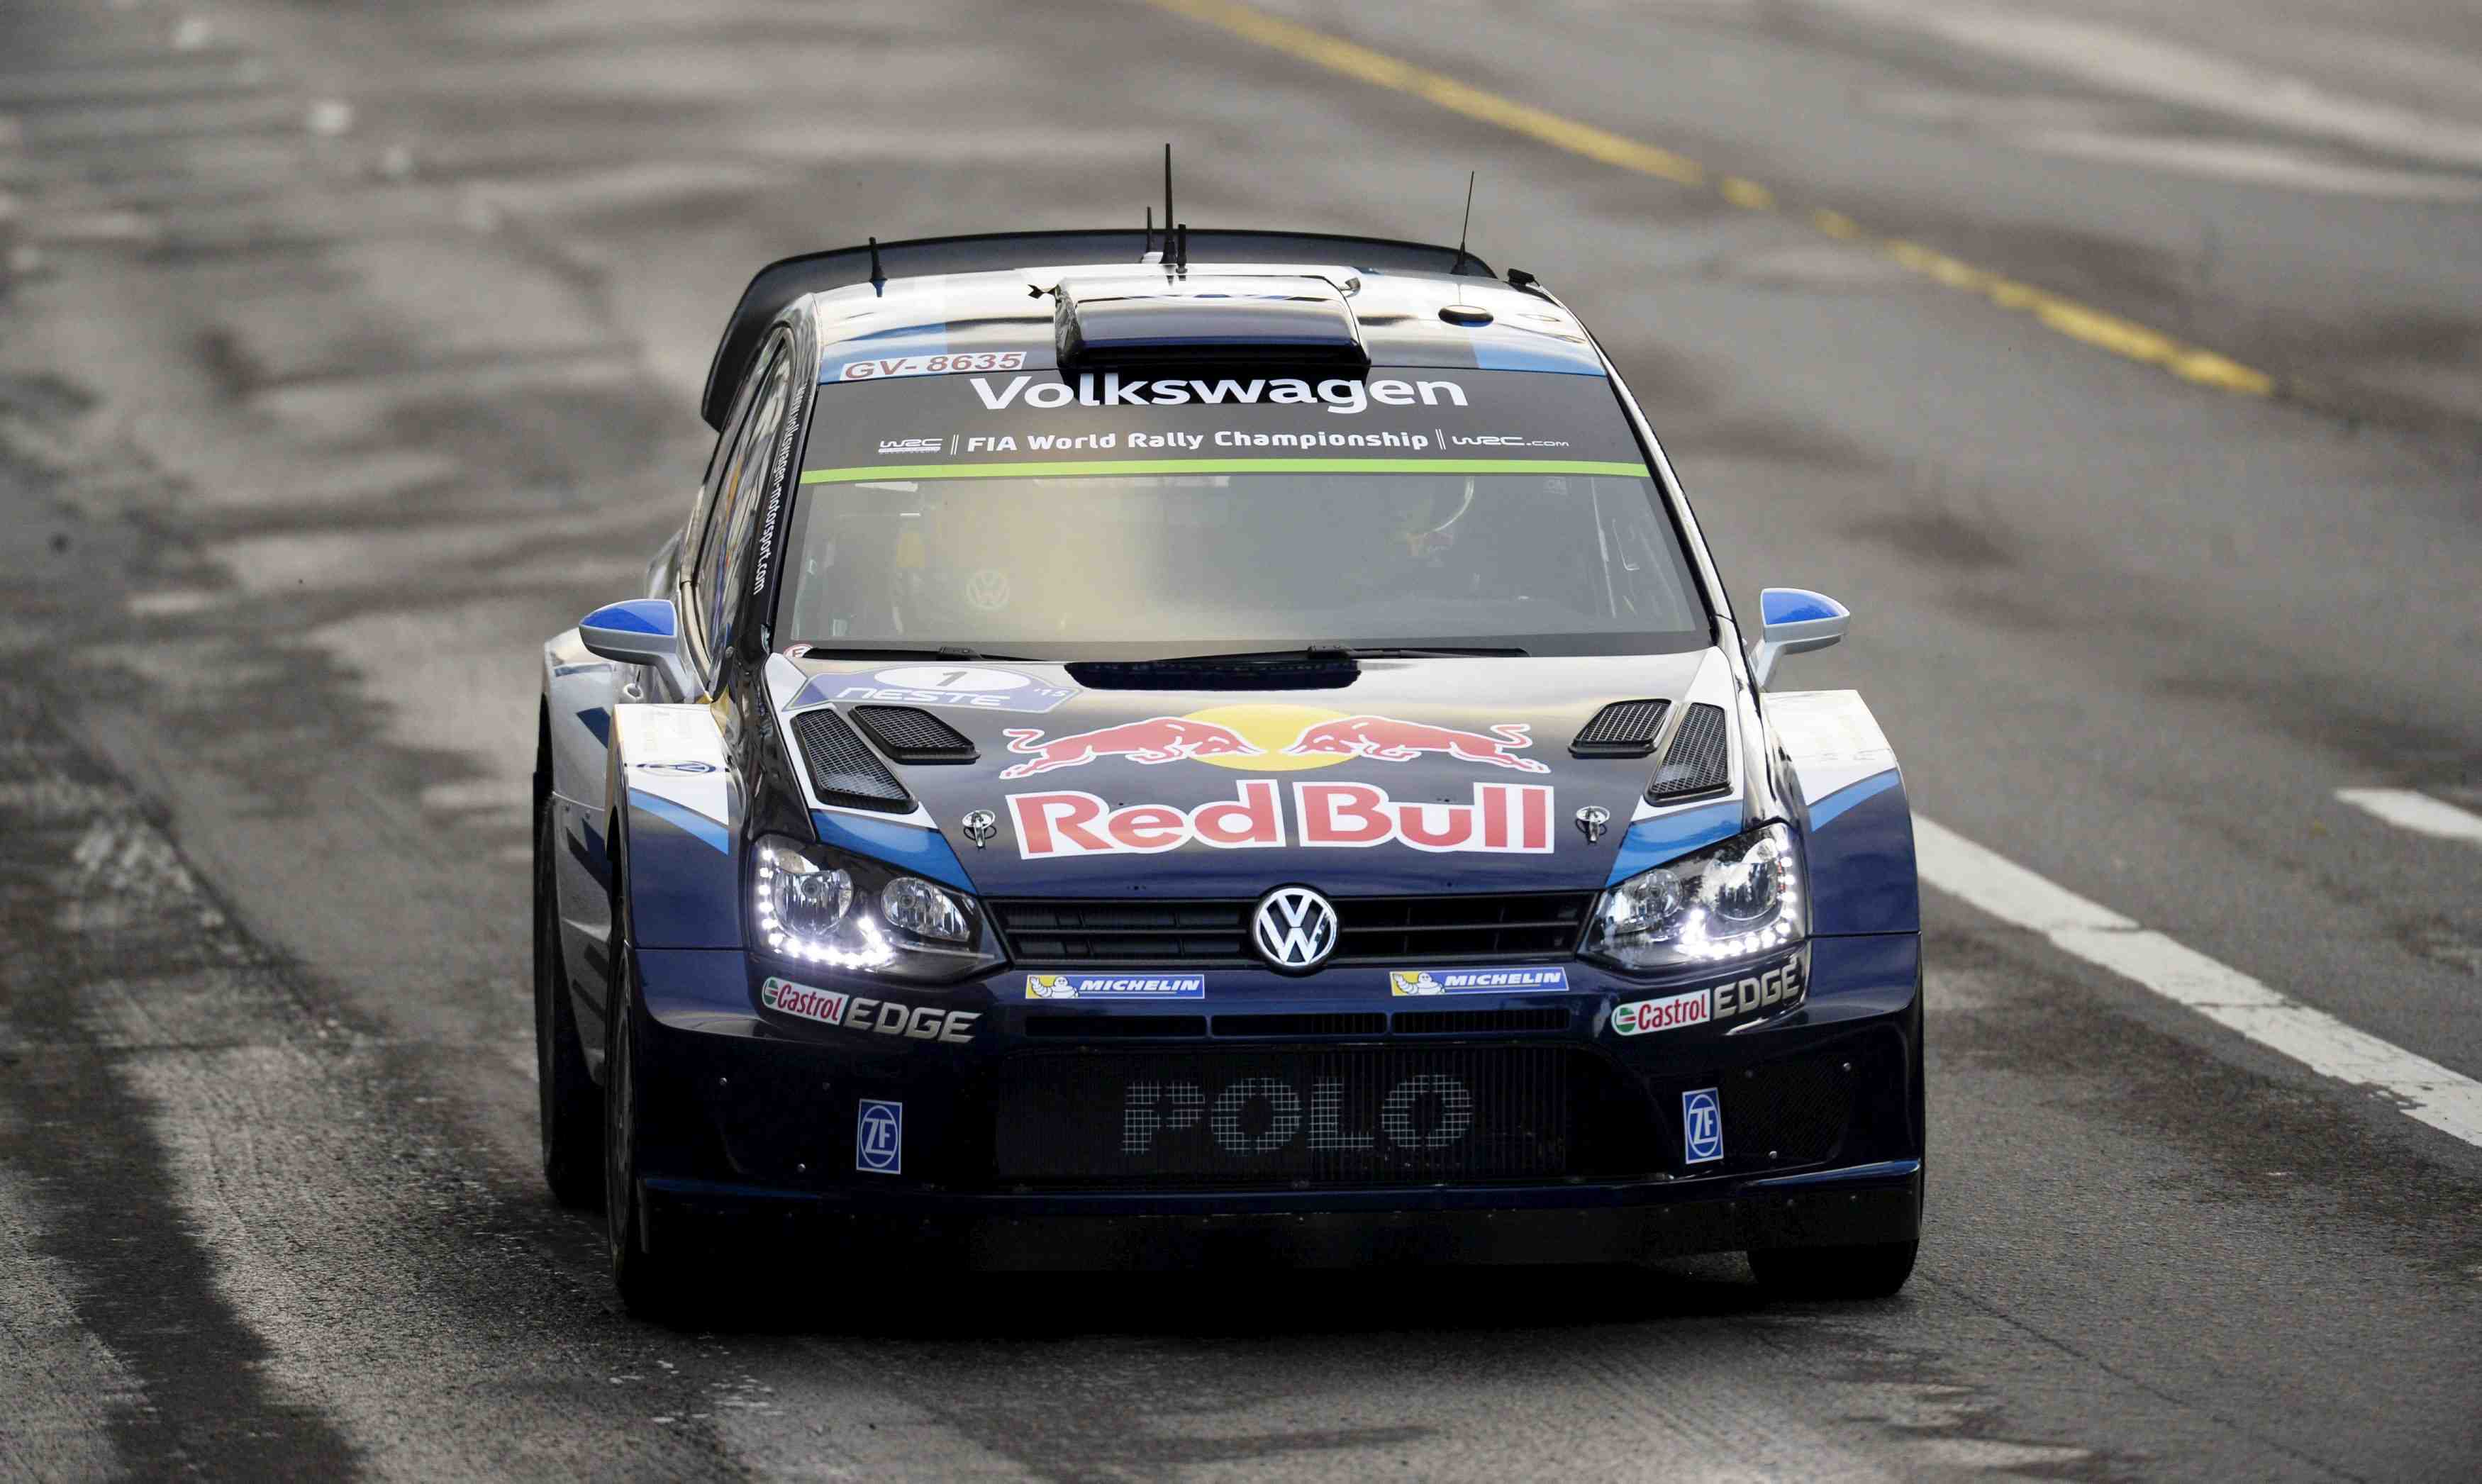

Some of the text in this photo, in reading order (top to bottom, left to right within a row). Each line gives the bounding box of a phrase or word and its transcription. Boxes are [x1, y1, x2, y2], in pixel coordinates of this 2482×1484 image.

[969, 372, 1469, 414] Volkswagen
[880, 438, 943, 447] WRC
[967, 436, 1017, 452] FIA
[1027, 433, 1115, 450] World
[1128, 432, 1203, 450] Rally
[1215, 430, 1428, 450] Championship
[836, 686, 1010, 706] NESTE
[936, 671, 967, 686] 1
[1006, 779, 1554, 859] Red Bull
[1254, 888, 1337, 966] VW
[1079, 979, 1200, 991] MICHELIN
[1445, 972, 1562, 986] MICHELIN
[1638, 957, 1801, 1031] Castrol EDGE
[777, 983, 983, 1044] Castrol EDGE
[1120, 1073, 1474, 1156] POLO
[1689, 1105, 1718, 1145] ZF
[863, 1117, 895, 1156] ZF
